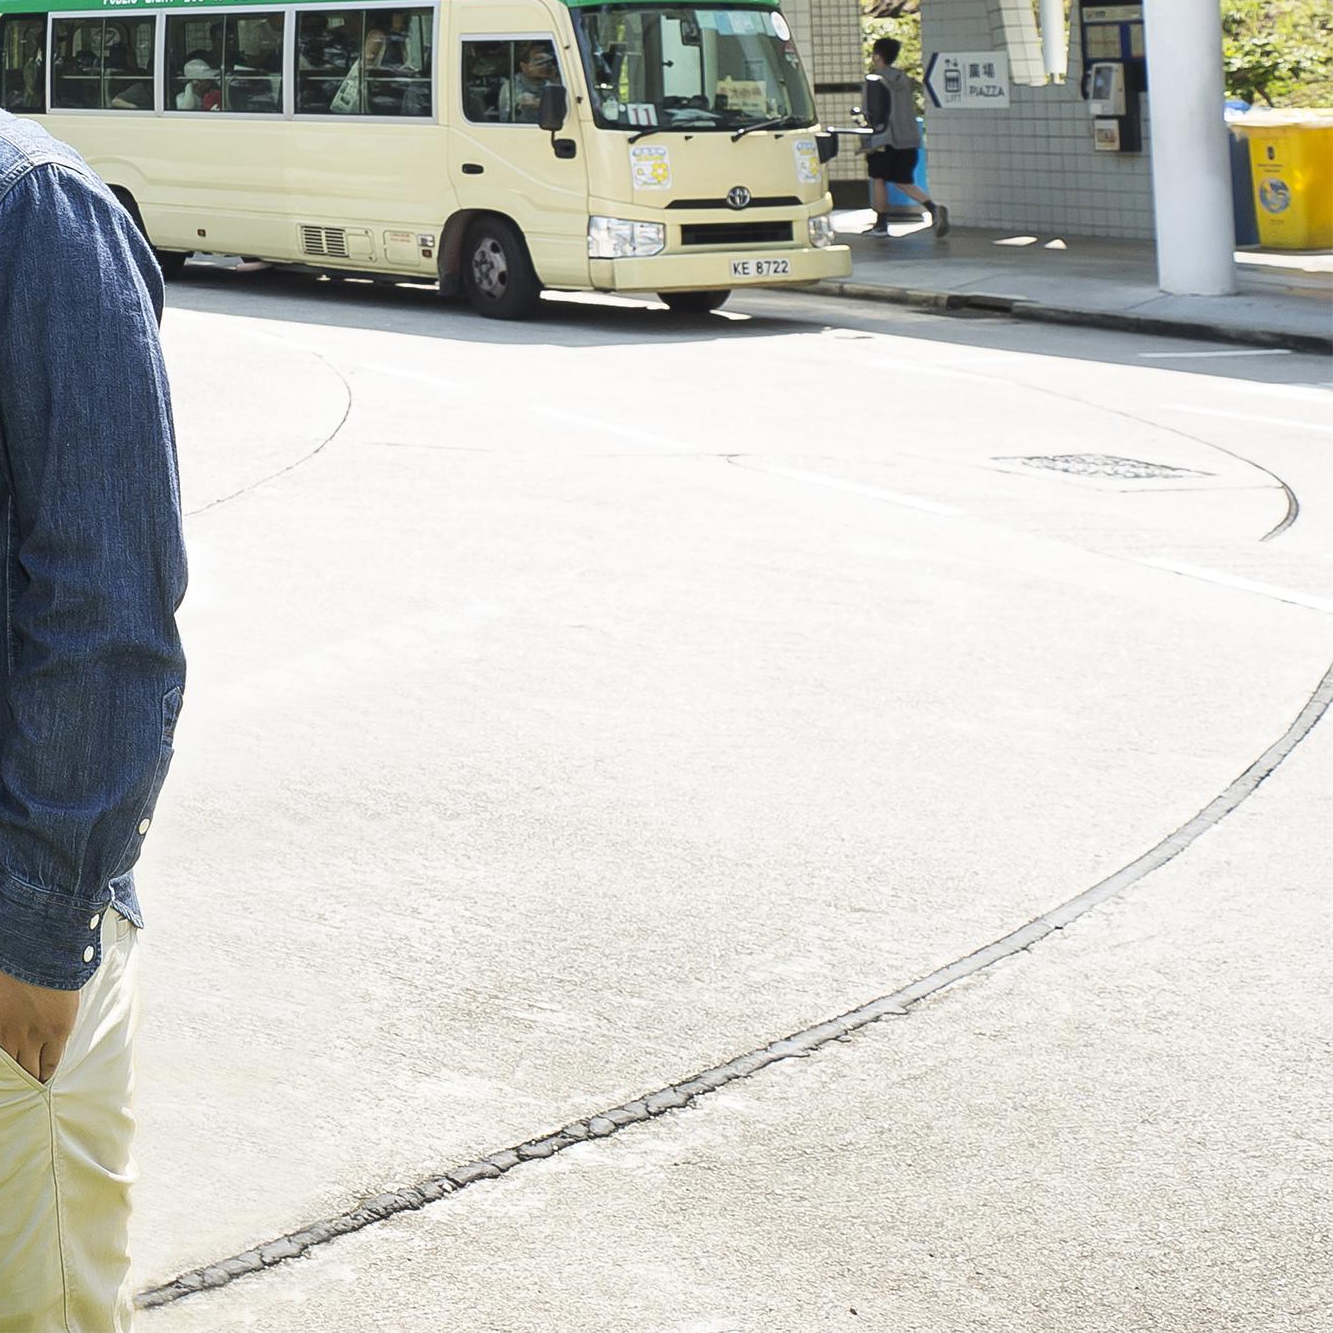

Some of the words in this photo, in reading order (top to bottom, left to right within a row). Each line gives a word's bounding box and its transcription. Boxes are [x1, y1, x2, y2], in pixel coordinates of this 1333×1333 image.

[969, 85, 1005, 98] PIAZZA
[632, 106, 653, 126] 11
[732, 262, 750, 276] KE
[756, 260, 789, 275] 8722
